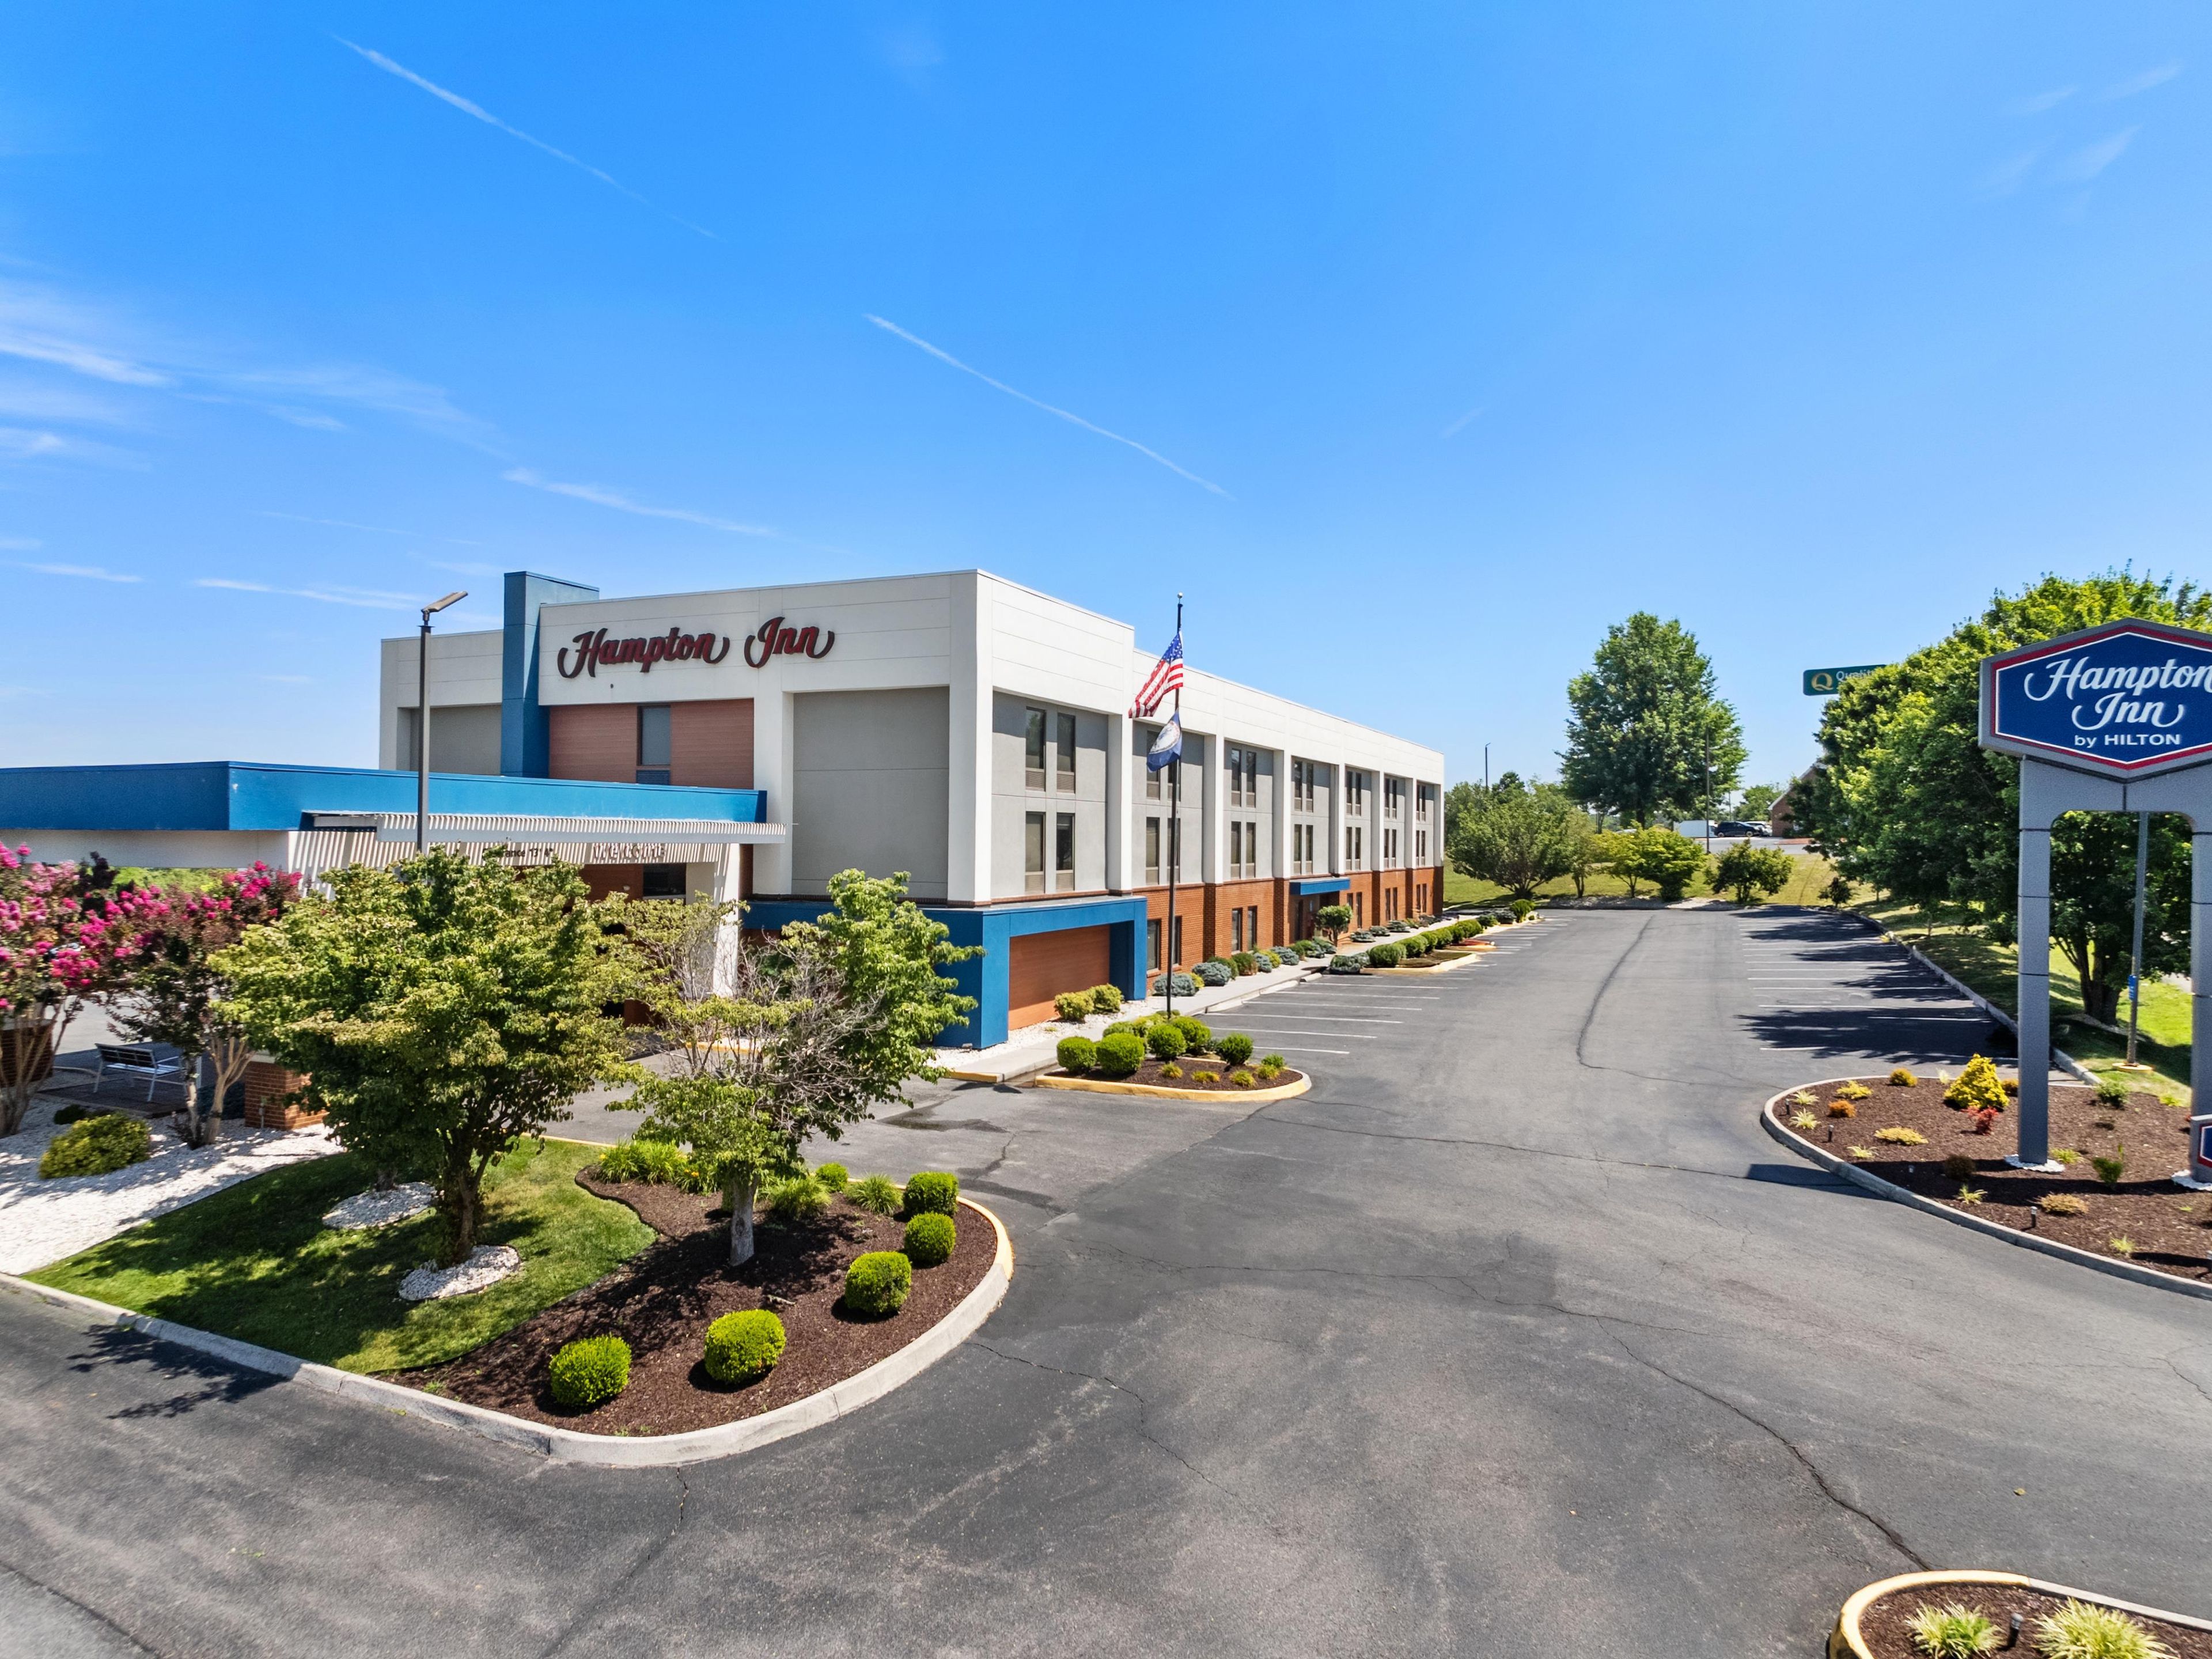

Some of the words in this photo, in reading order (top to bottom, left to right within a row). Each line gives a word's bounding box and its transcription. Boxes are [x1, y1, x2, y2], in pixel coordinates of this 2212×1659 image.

[557, 627, 730, 679] Hampton
[744, 616, 835, 669] Inn
[2024, 656, 2212, 701] Hampton
[2071, 692, 2185, 730] Inn
[2074, 735, 2097, 748] by
[2104, 734, 2181, 745] HILTON
